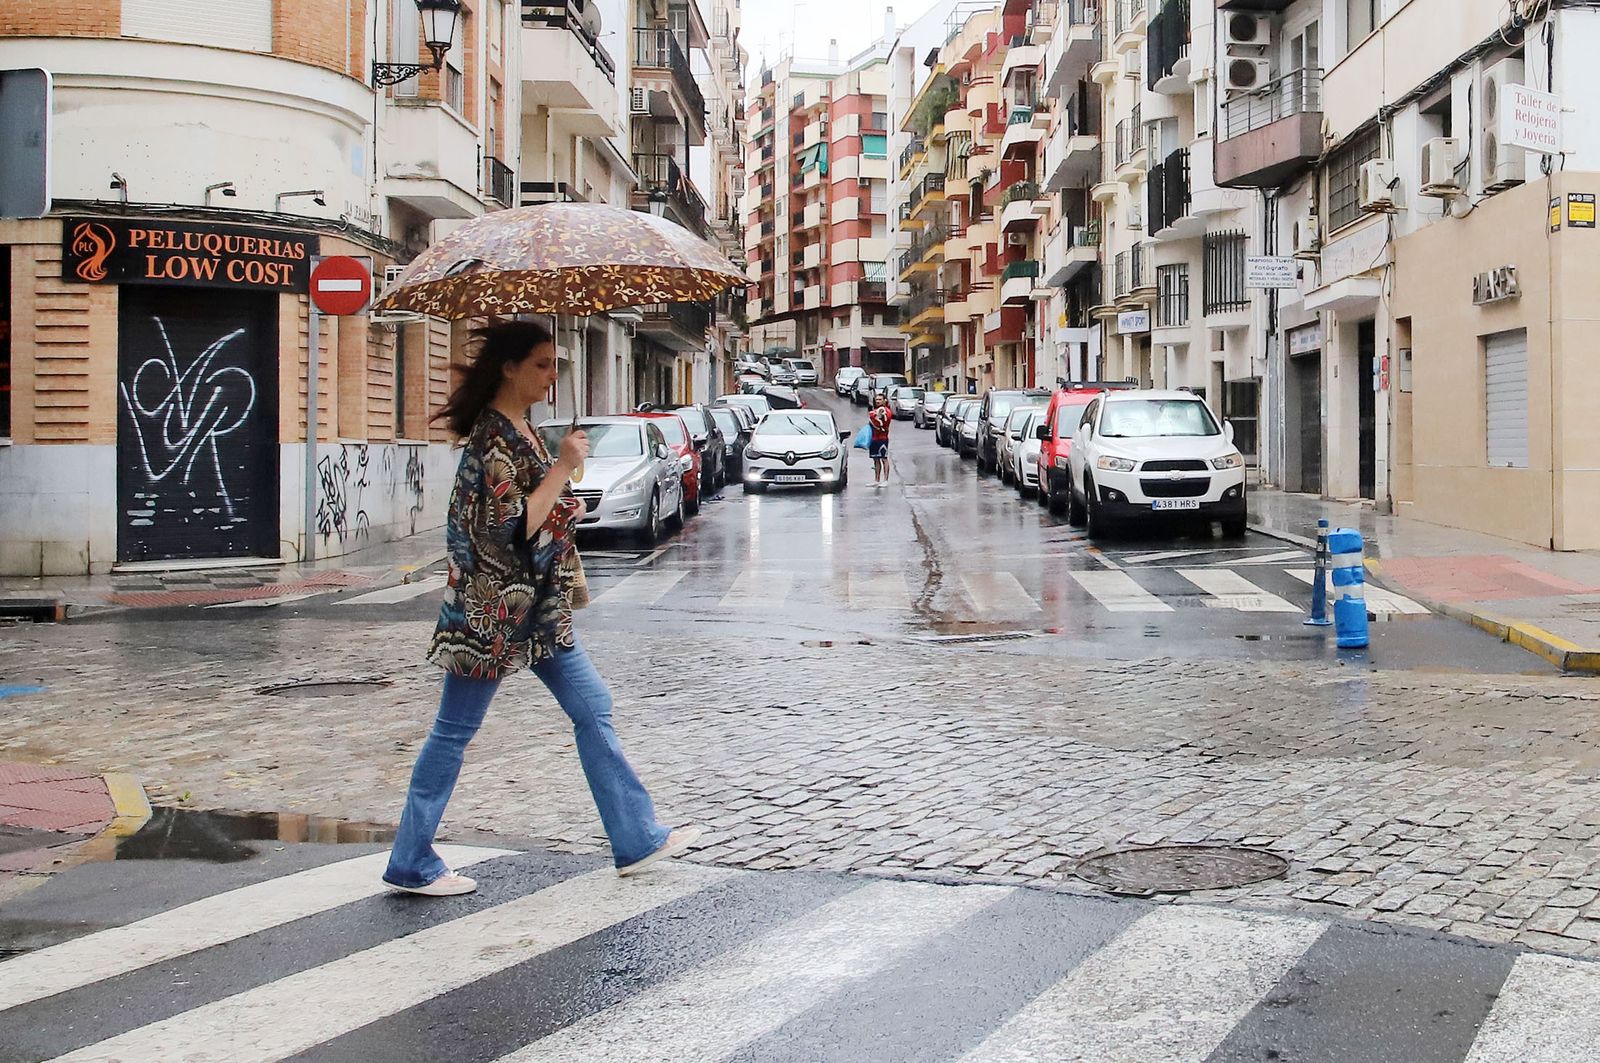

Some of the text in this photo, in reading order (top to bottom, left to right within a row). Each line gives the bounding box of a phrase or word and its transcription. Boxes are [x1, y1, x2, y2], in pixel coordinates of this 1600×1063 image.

[1515, 91, 1557, 112] Taller de
[1515, 128, 1520, 140] y
[79, 241, 94, 251] PLC
[128, 228, 305, 260] PELUQUERIAS
[145, 255, 294, 286] LOW COST
[1156, 500, 1197, 508] 4381 HRS
